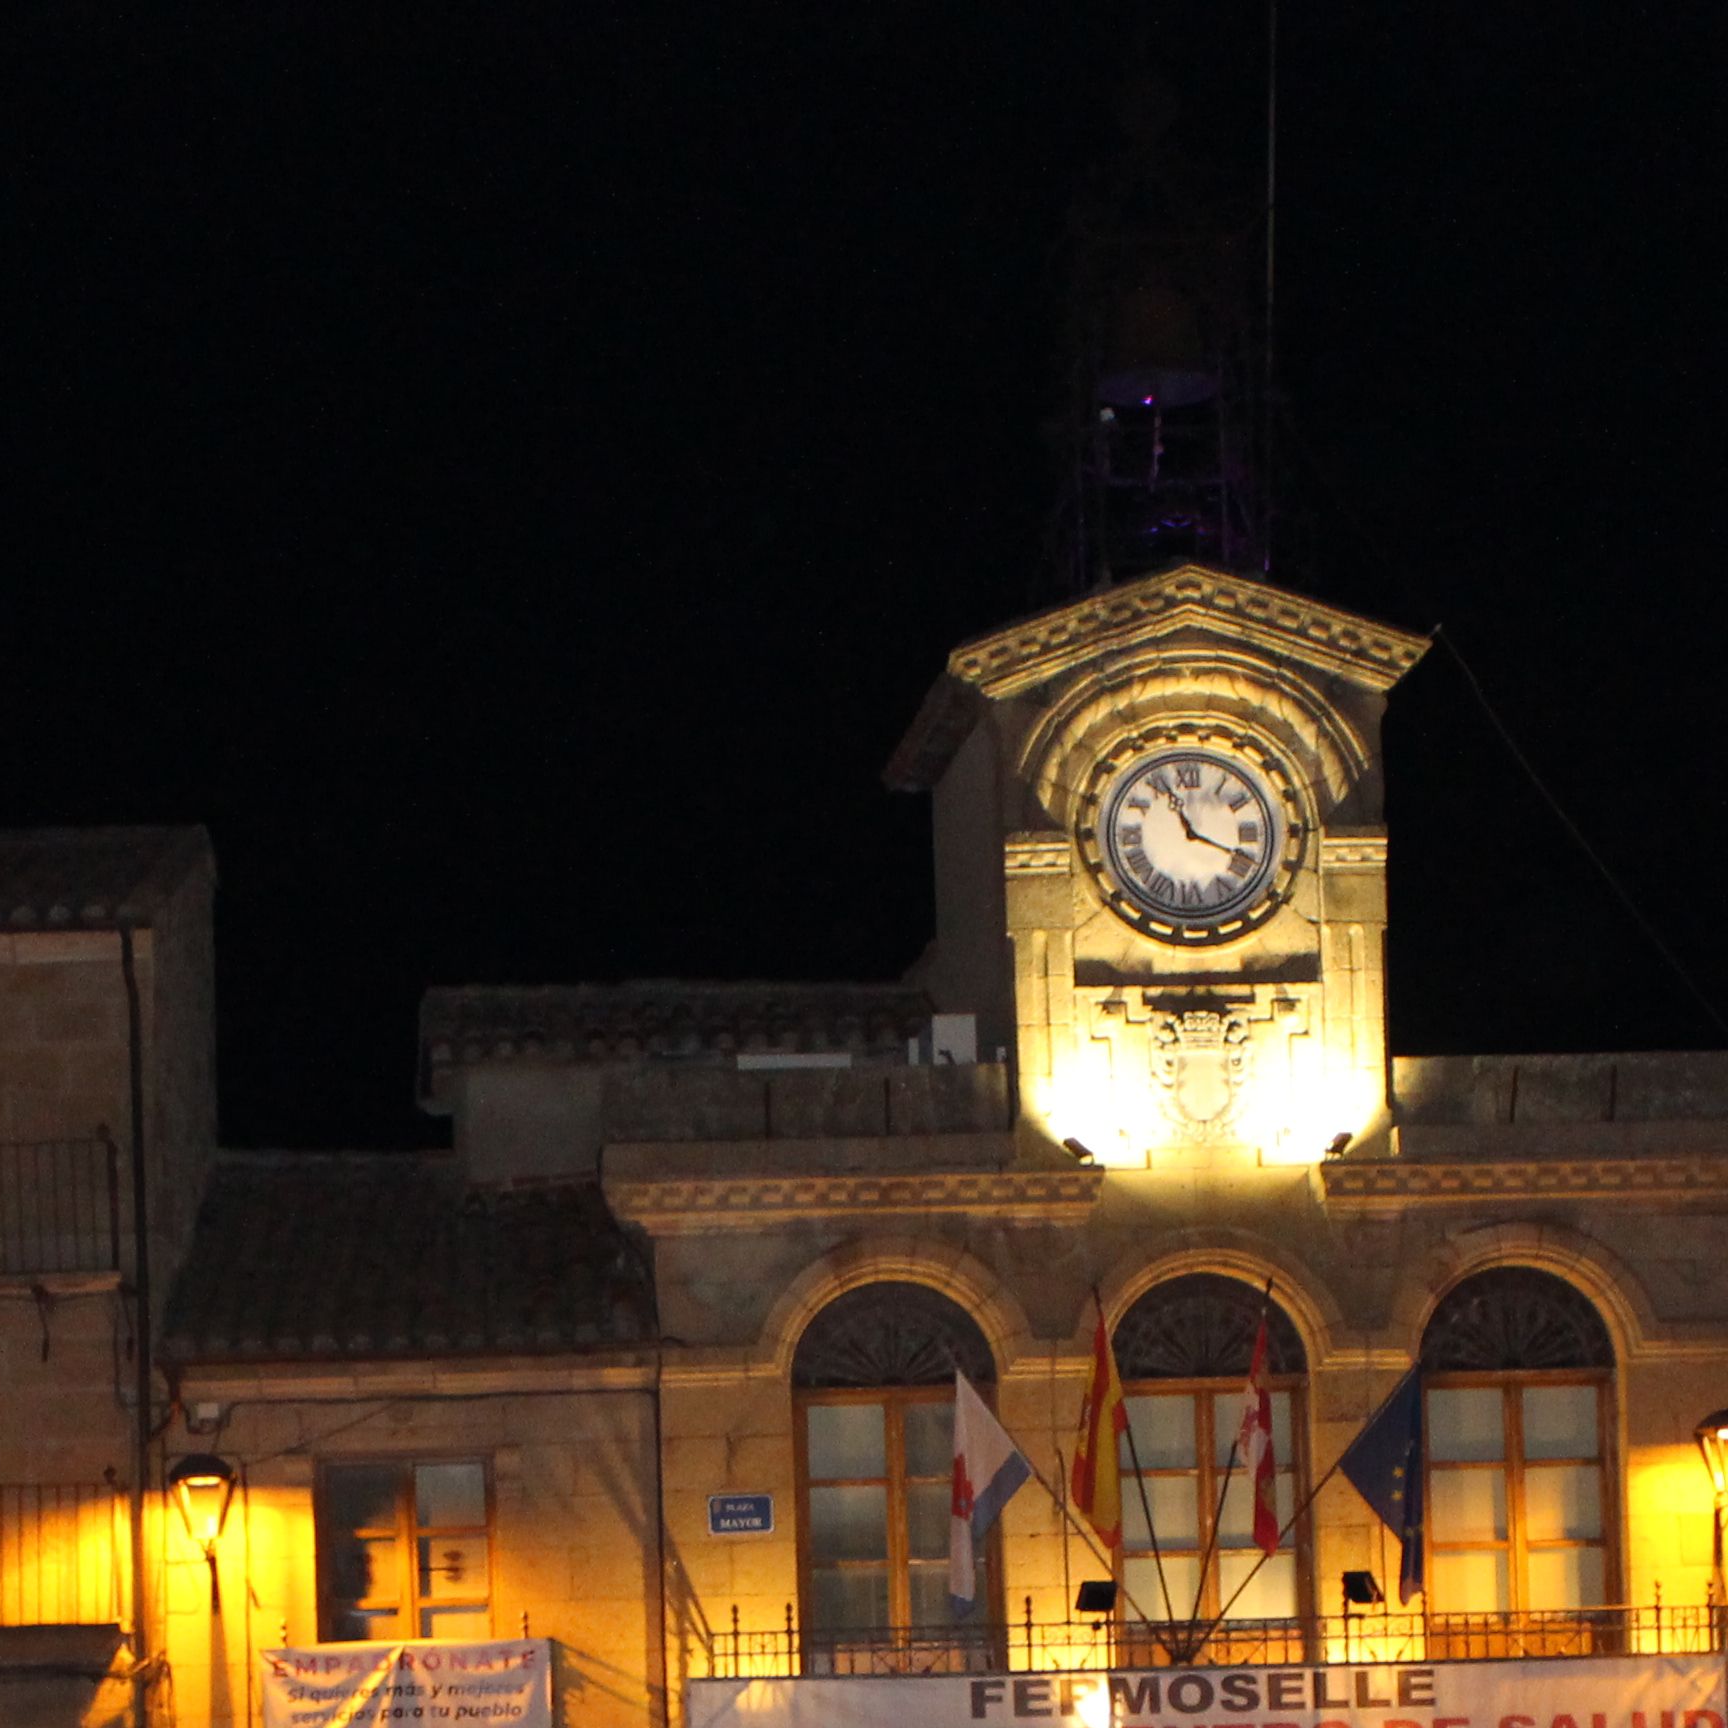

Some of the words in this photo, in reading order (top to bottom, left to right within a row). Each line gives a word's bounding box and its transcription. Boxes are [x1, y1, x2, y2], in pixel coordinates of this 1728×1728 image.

[719, 1516, 763, 1529] MAYOR
[310, 1683, 381, 1704] quieres
[385, 1682, 426, 1698] más
[432, 1681, 444, 1698] y
[447, 1679, 525, 1702] mejores
[970, 1669, 1437, 1719] FERMOSELLE
[291, 1705, 375, 1725] servicios
[380, 1705, 425, 1722] para
[431, 1705, 450, 1718] tu
[454, 1700, 522, 1720] pueblo
